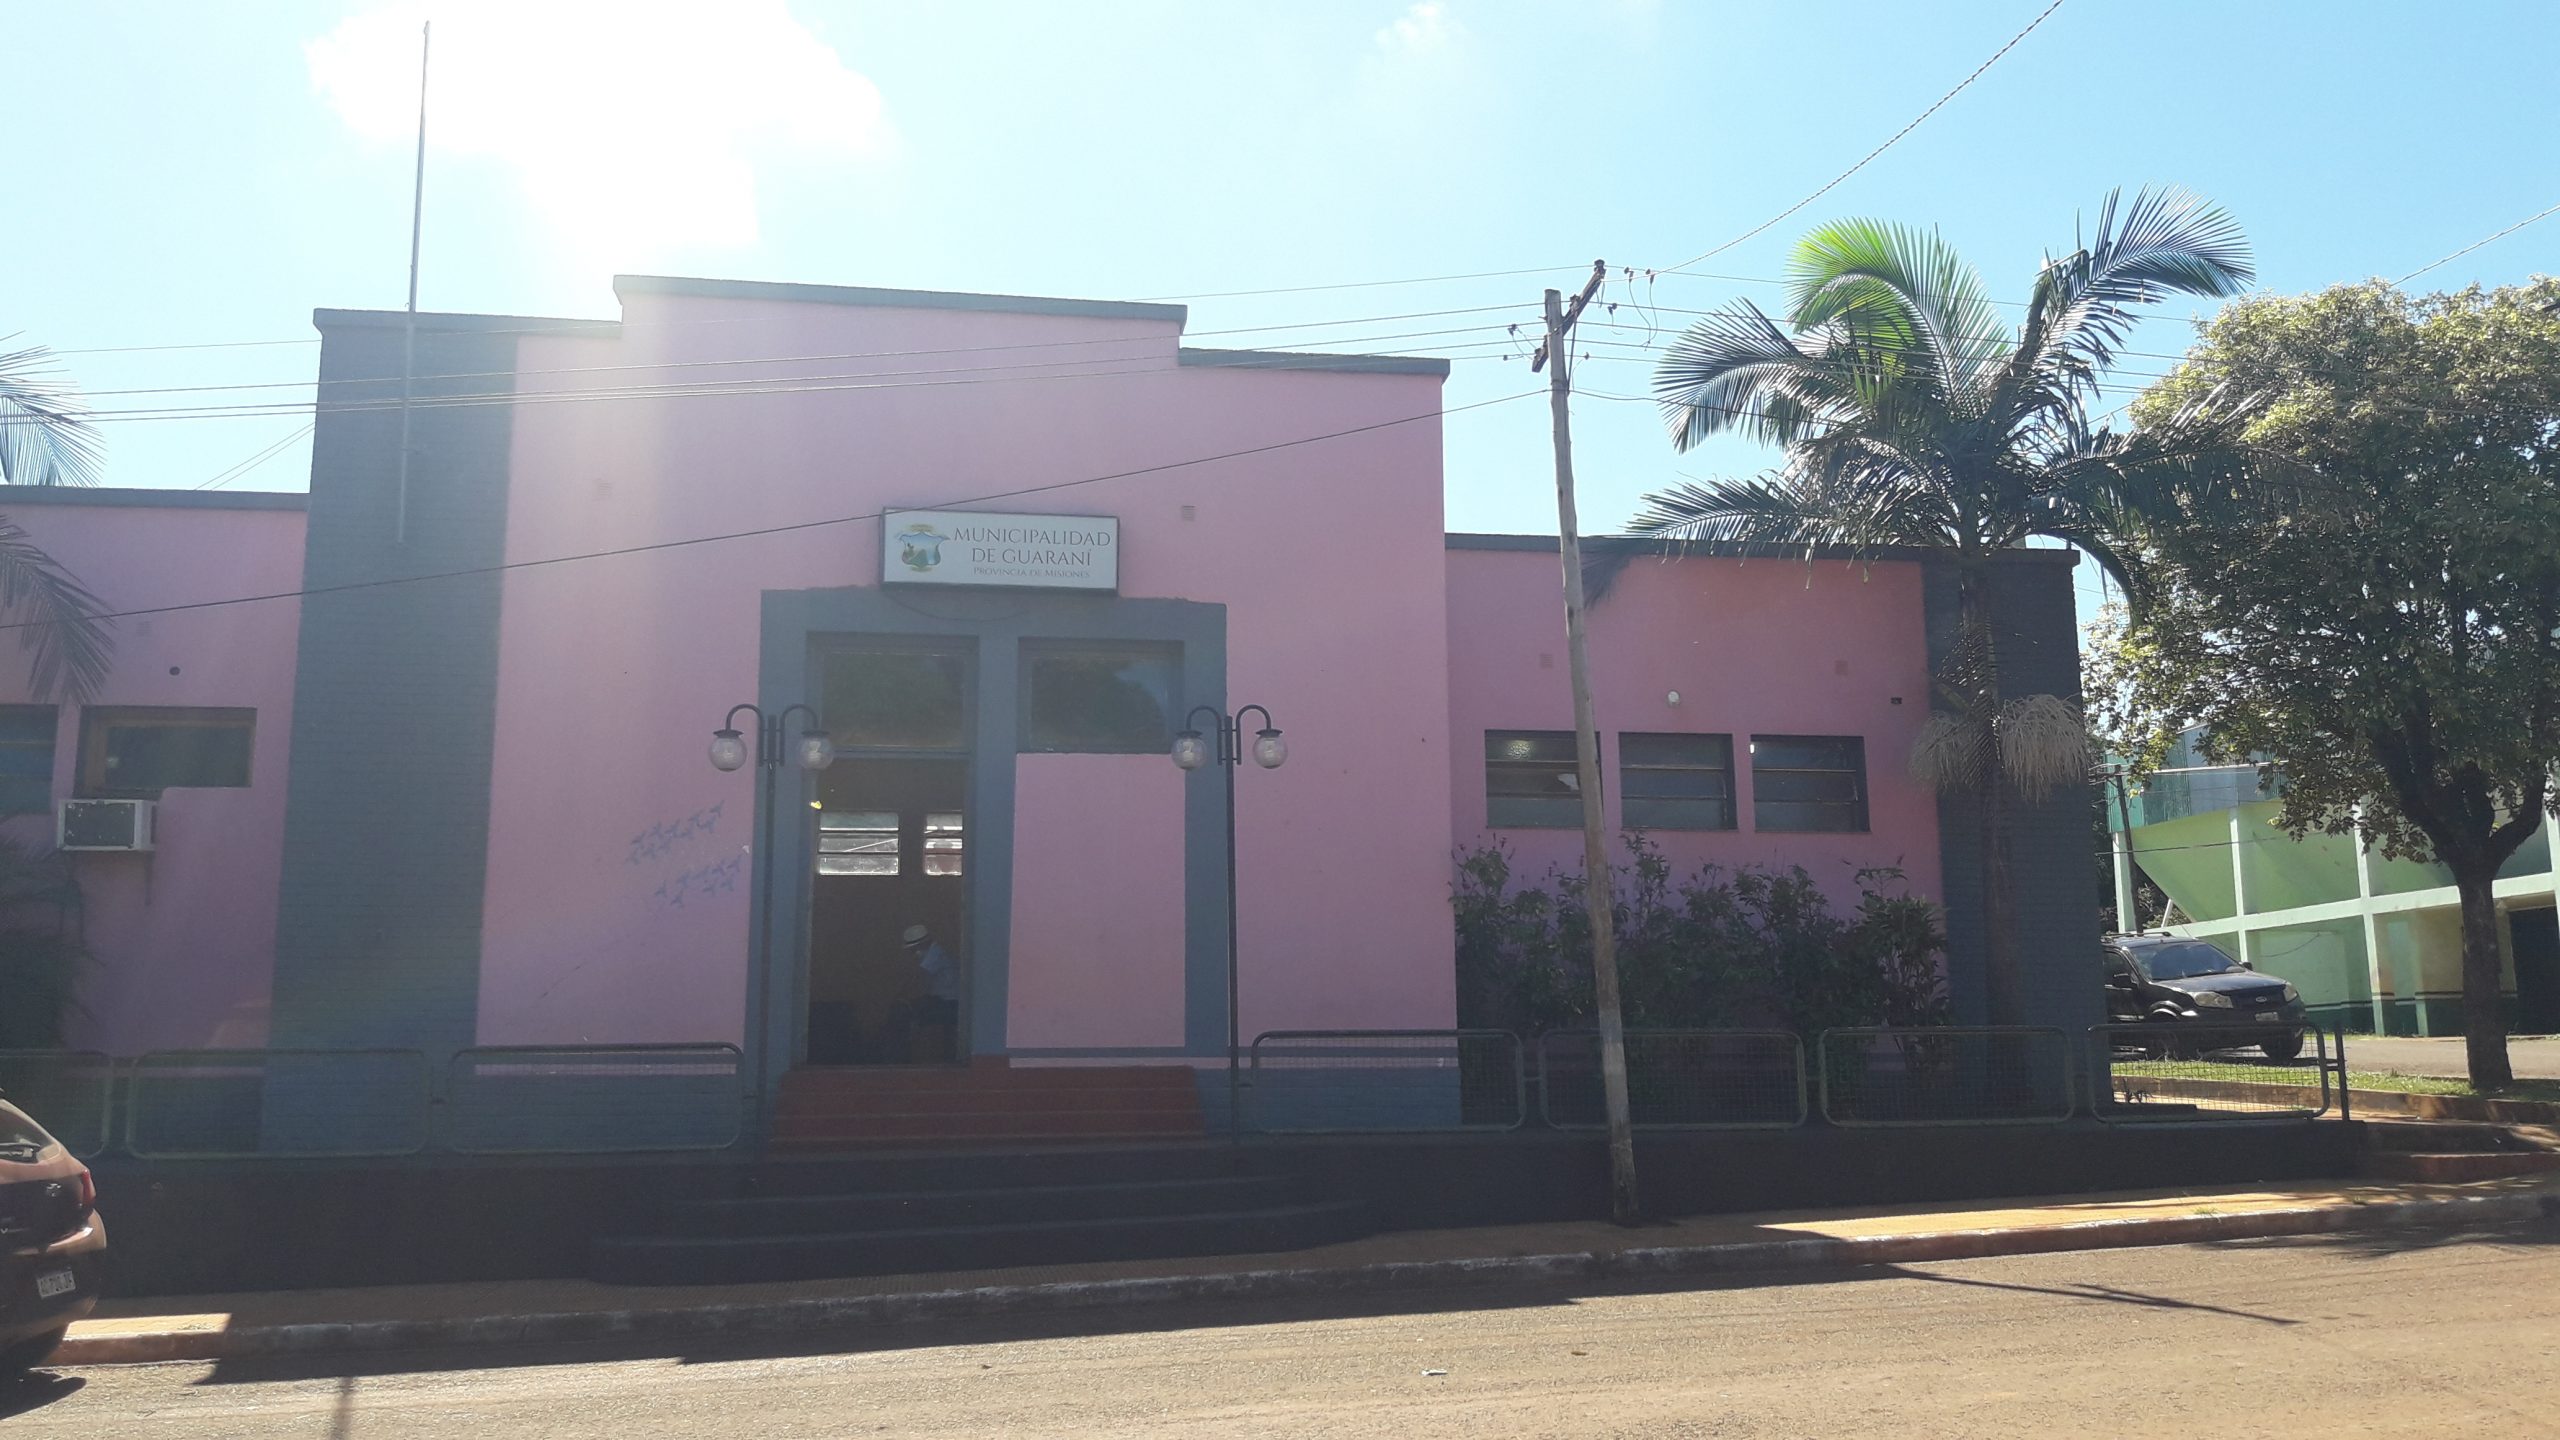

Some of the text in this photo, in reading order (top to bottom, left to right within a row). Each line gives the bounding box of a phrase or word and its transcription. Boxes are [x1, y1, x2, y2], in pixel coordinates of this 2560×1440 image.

[954, 527, 1111, 546] MUNICIPALIDAD
[972, 548, 1092, 566] DE GUARANÍ
[974, 567, 1090, 579] PROVINCIA DE MISIONES
